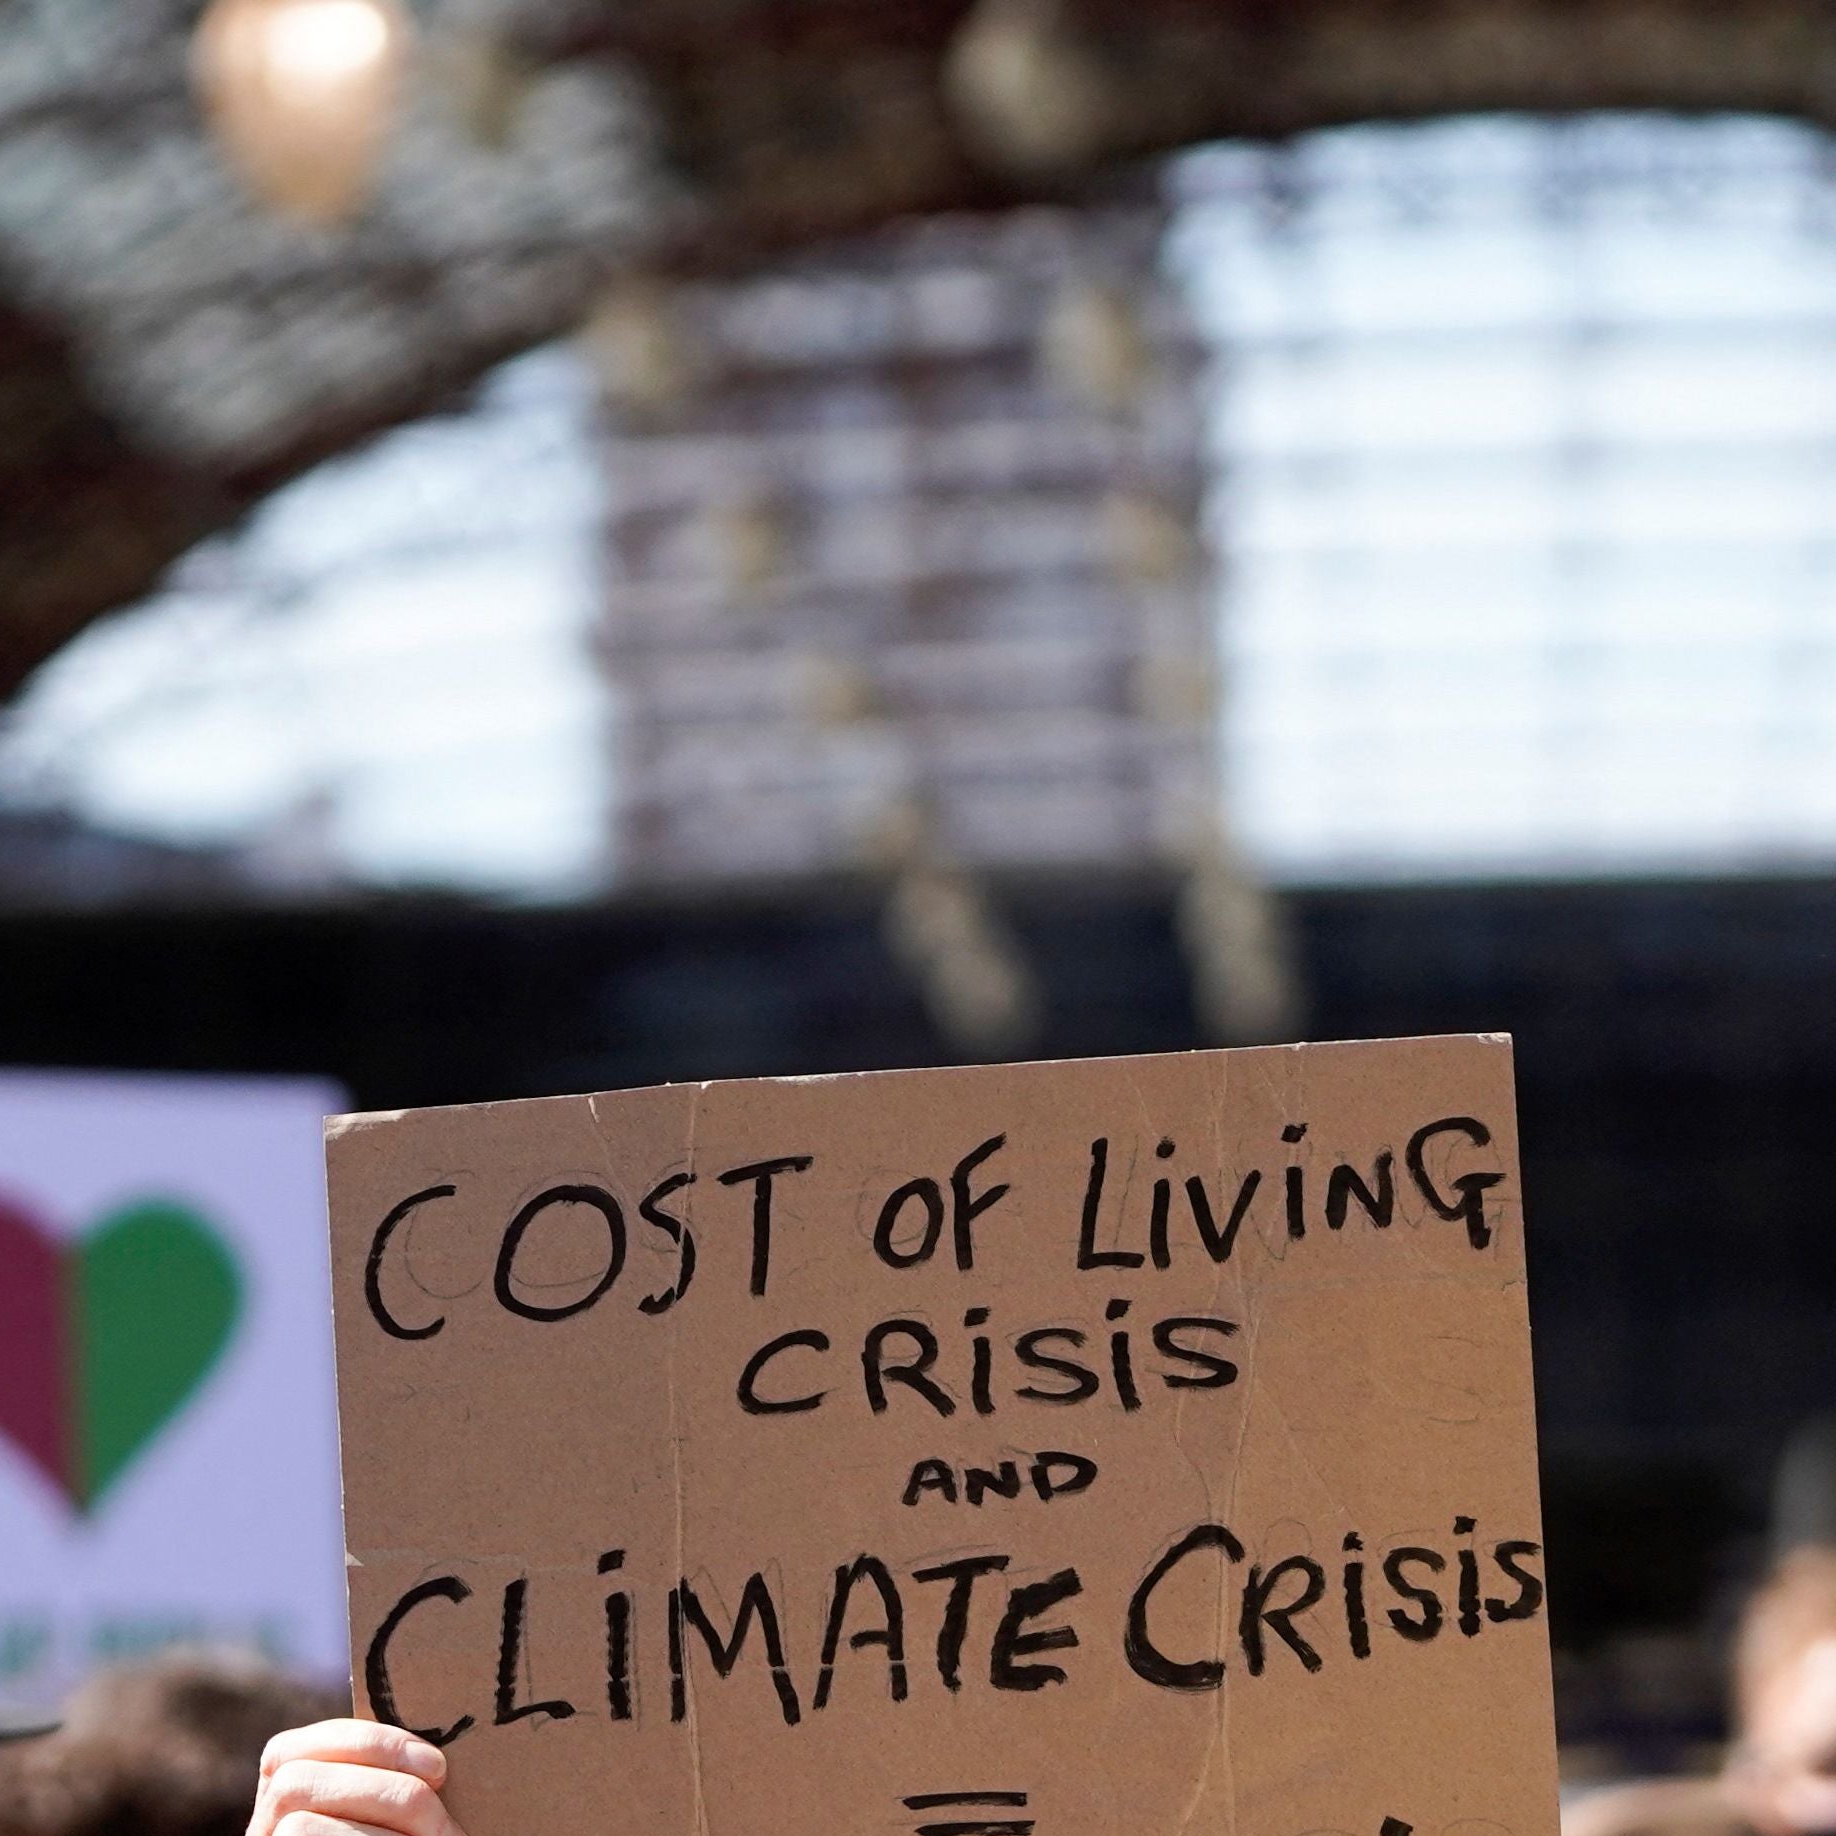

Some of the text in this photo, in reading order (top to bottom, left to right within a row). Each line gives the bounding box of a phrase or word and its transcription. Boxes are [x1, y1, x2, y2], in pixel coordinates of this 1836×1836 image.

[364, 1156, 813, 1340] COST
[873, 1132, 1010, 1272] OF
[902, 1451, 1098, 1508] AND
